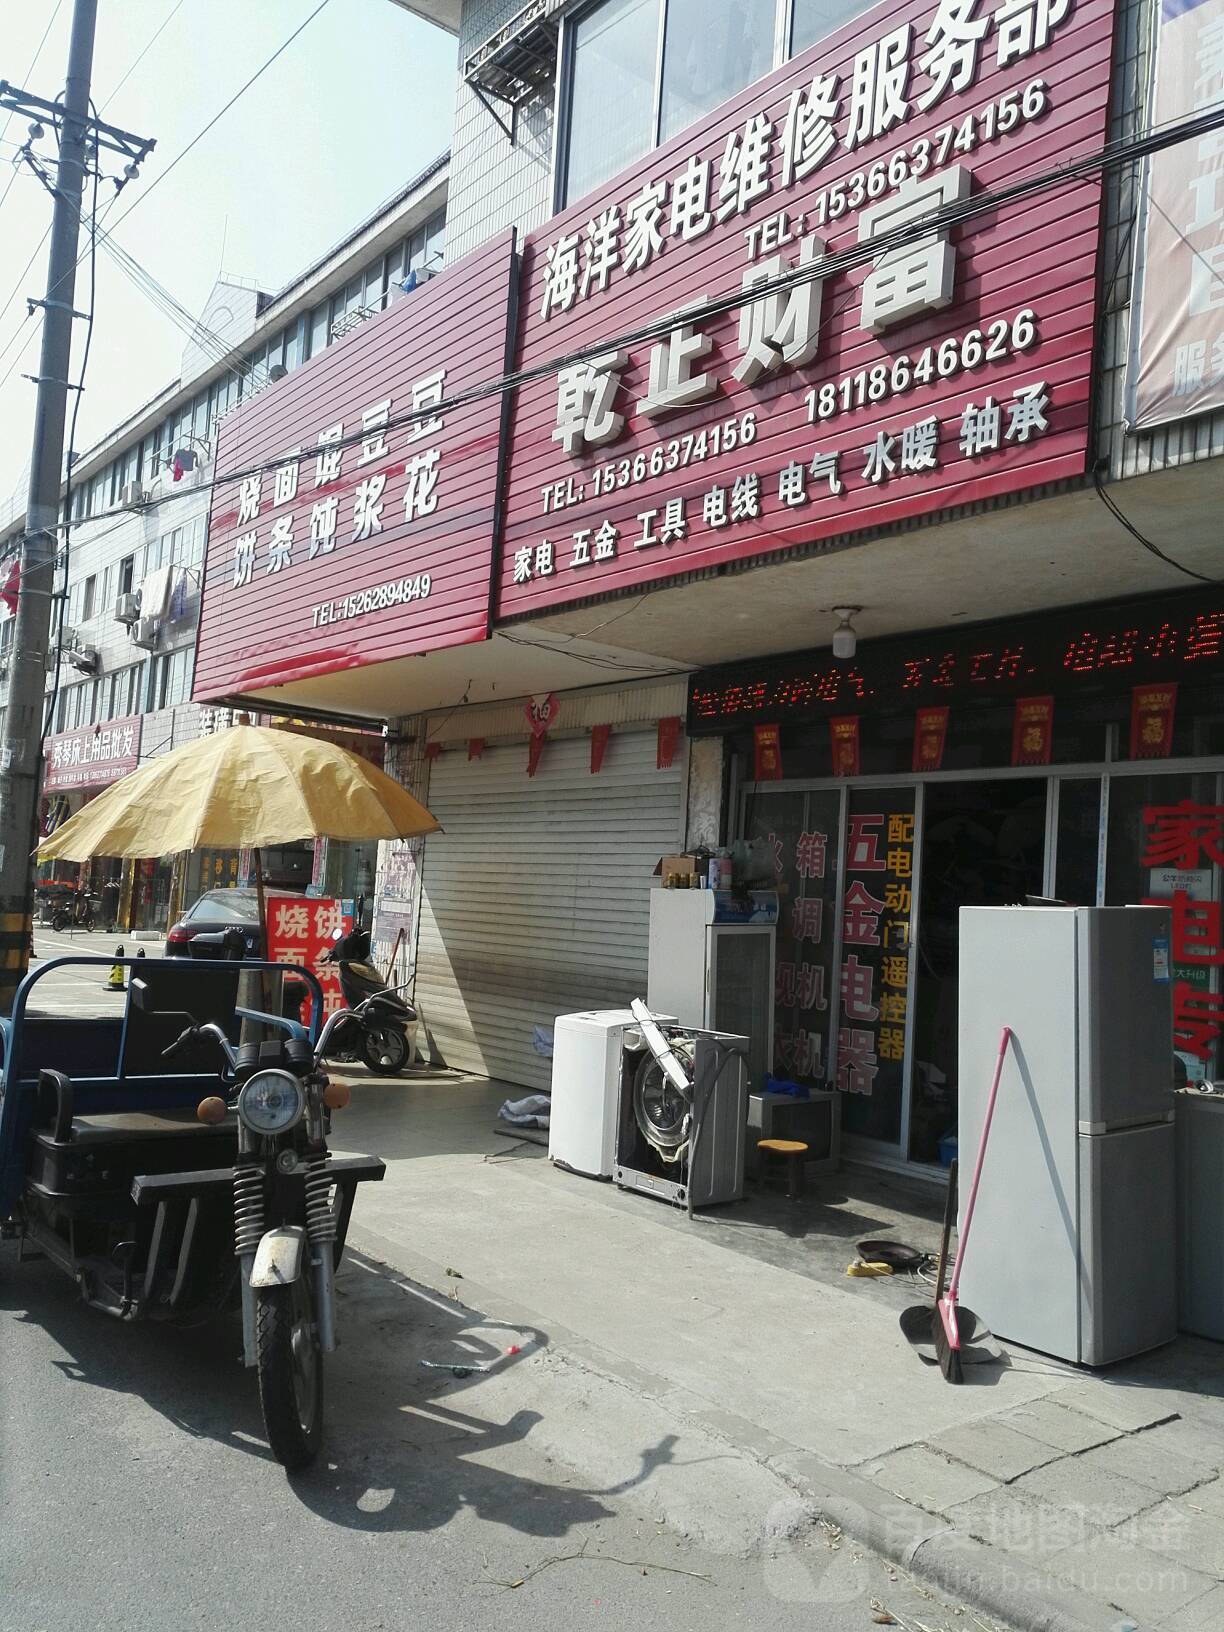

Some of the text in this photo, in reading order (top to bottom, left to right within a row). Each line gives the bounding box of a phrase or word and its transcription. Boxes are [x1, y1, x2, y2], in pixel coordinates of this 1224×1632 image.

[540, 0, 1070, 321] 海洋家电维修服务部
[804, 308, 1037, 422] 18118646626
[513, 380, 1050, 583] 家电 五金 工具 电线 电气 水暖 轴承
[52, 725, 134, 769] 秀琴床上用品批发
[275, 904, 347, 940] 烧饼
[878, 813, 915, 1061] 配电动门遥控器
